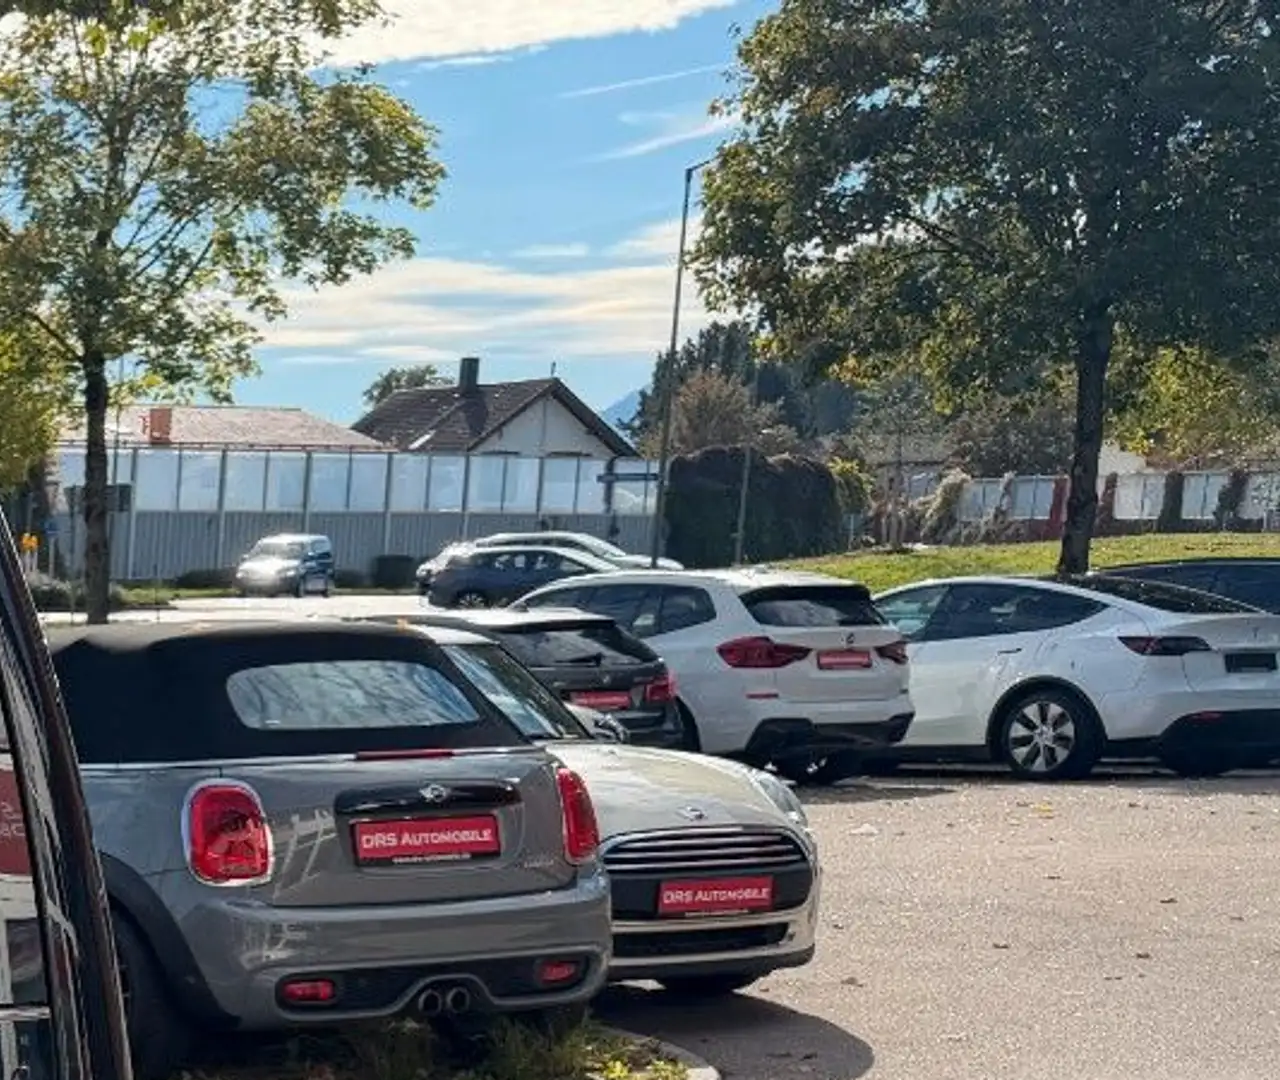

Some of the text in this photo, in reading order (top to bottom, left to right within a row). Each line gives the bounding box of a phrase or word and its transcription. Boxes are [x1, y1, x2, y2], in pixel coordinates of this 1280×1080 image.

[361, 829, 493, 849] DRS AUTOMOBILE
[663, 887, 771, 904] DRS AUTOMOBILE
